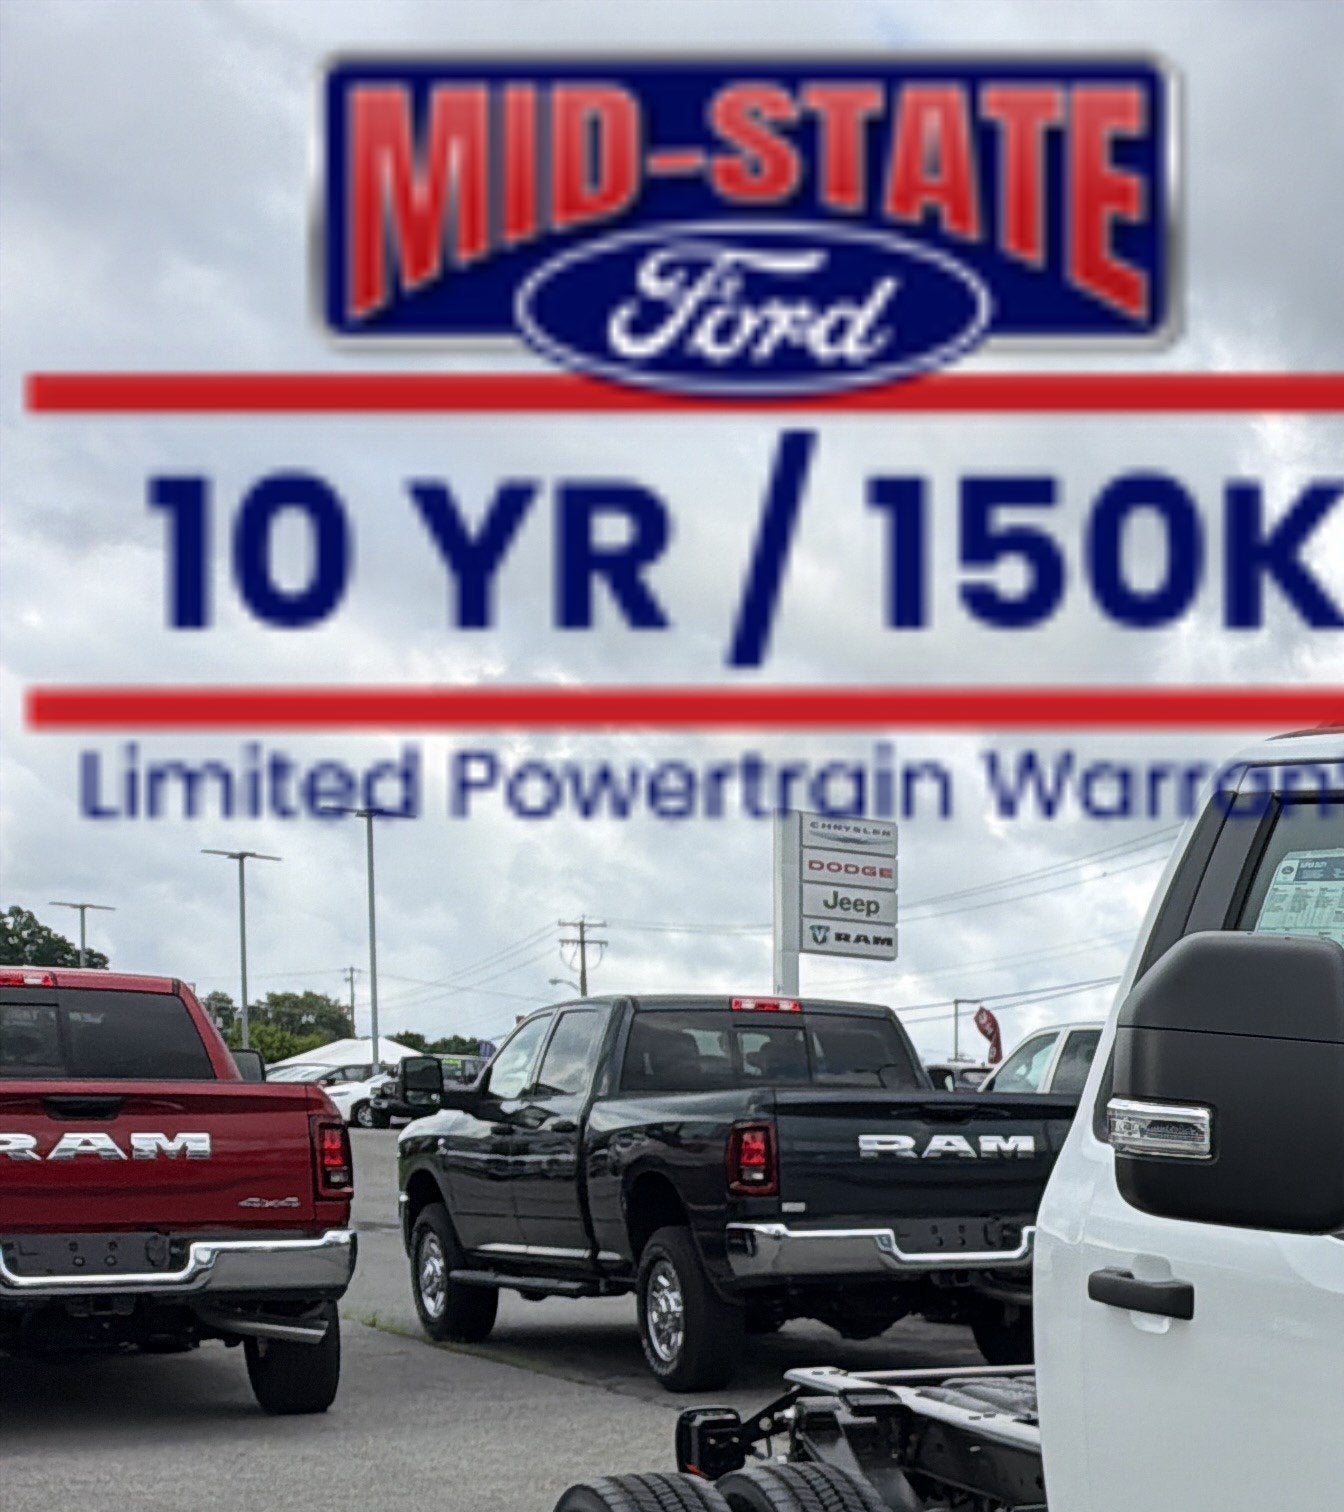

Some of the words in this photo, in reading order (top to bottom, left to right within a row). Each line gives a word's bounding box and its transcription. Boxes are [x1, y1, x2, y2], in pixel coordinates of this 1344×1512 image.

[809, 821, 892, 837] CHRYSLER
[808, 859, 893, 879] DODGE
[823, 890, 880, 917] Jeep
[834, 931, 893, 947] RAM
[858, 1134, 1035, 1159] RAM
